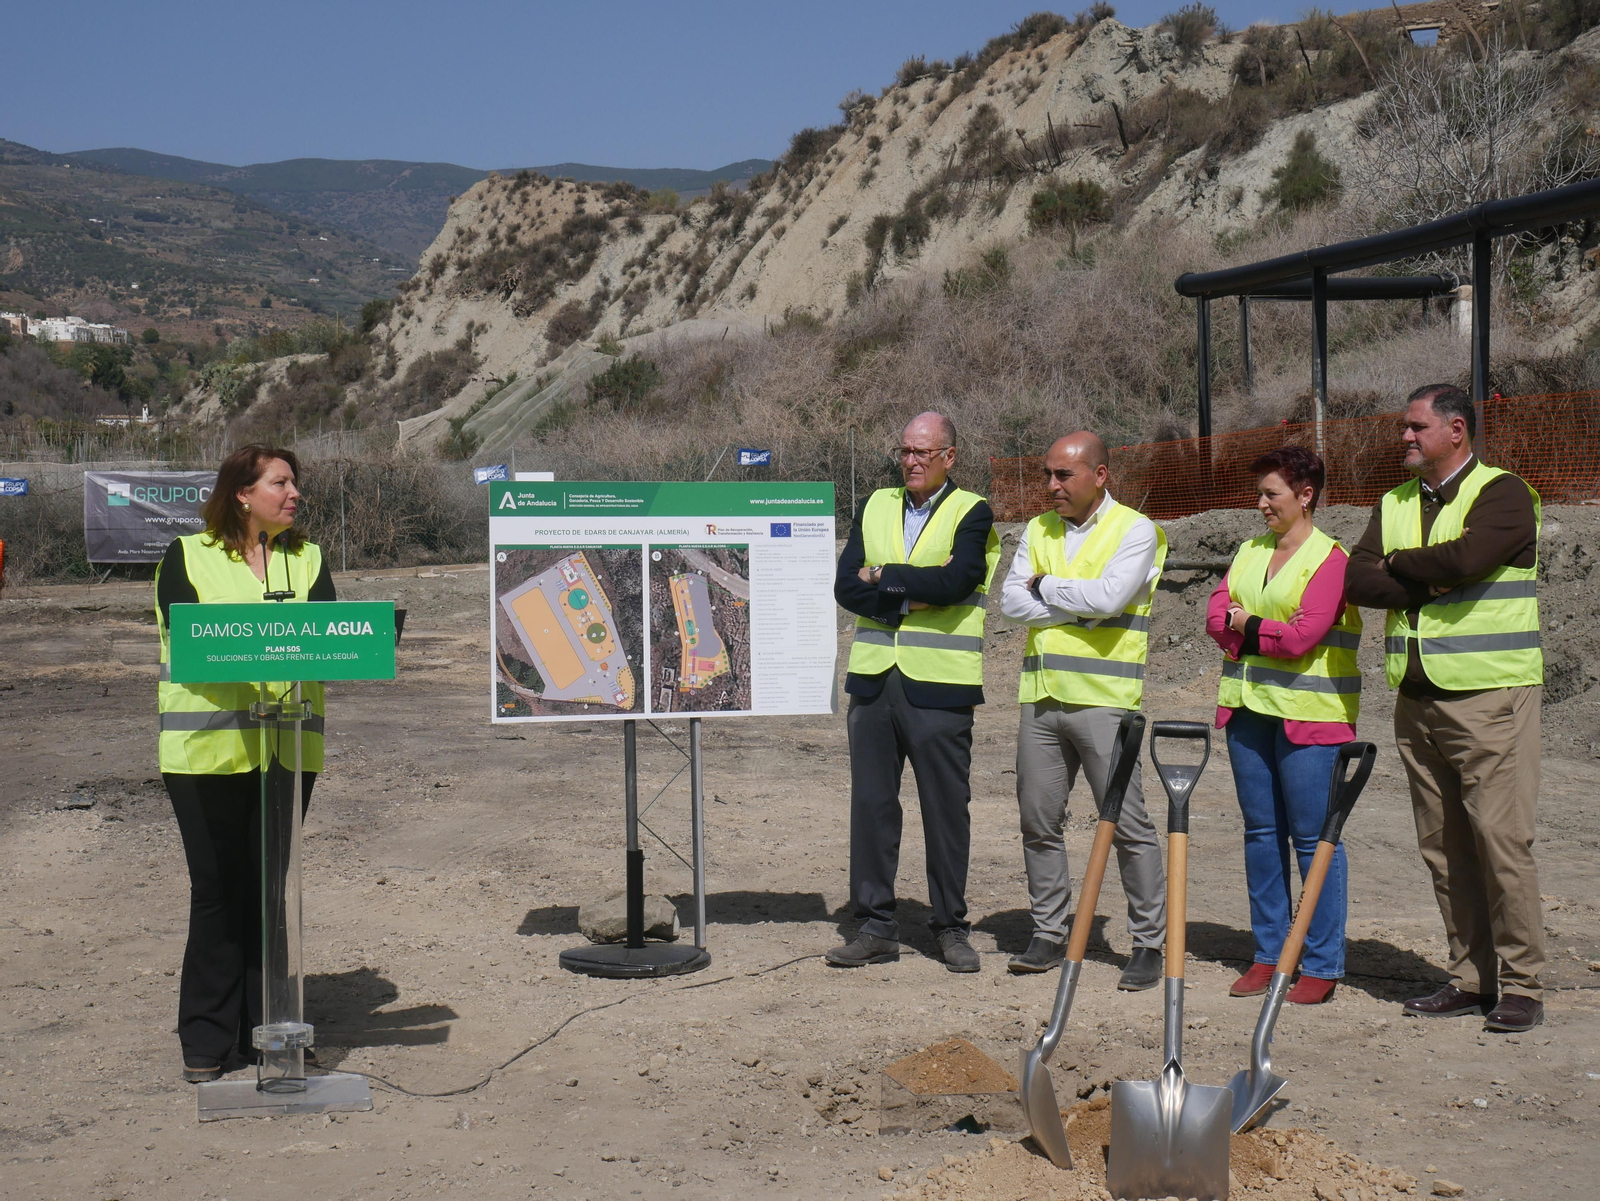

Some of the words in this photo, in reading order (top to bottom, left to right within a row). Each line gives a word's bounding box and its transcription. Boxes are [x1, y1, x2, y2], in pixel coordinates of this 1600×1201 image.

[134, 486, 214, 502] GRUPOC
[191, 623, 253, 637] DAMOS
[257, 622, 297, 636] VIDA
[300, 622, 321, 636] AL
[326, 621, 373, 636] AGUA
